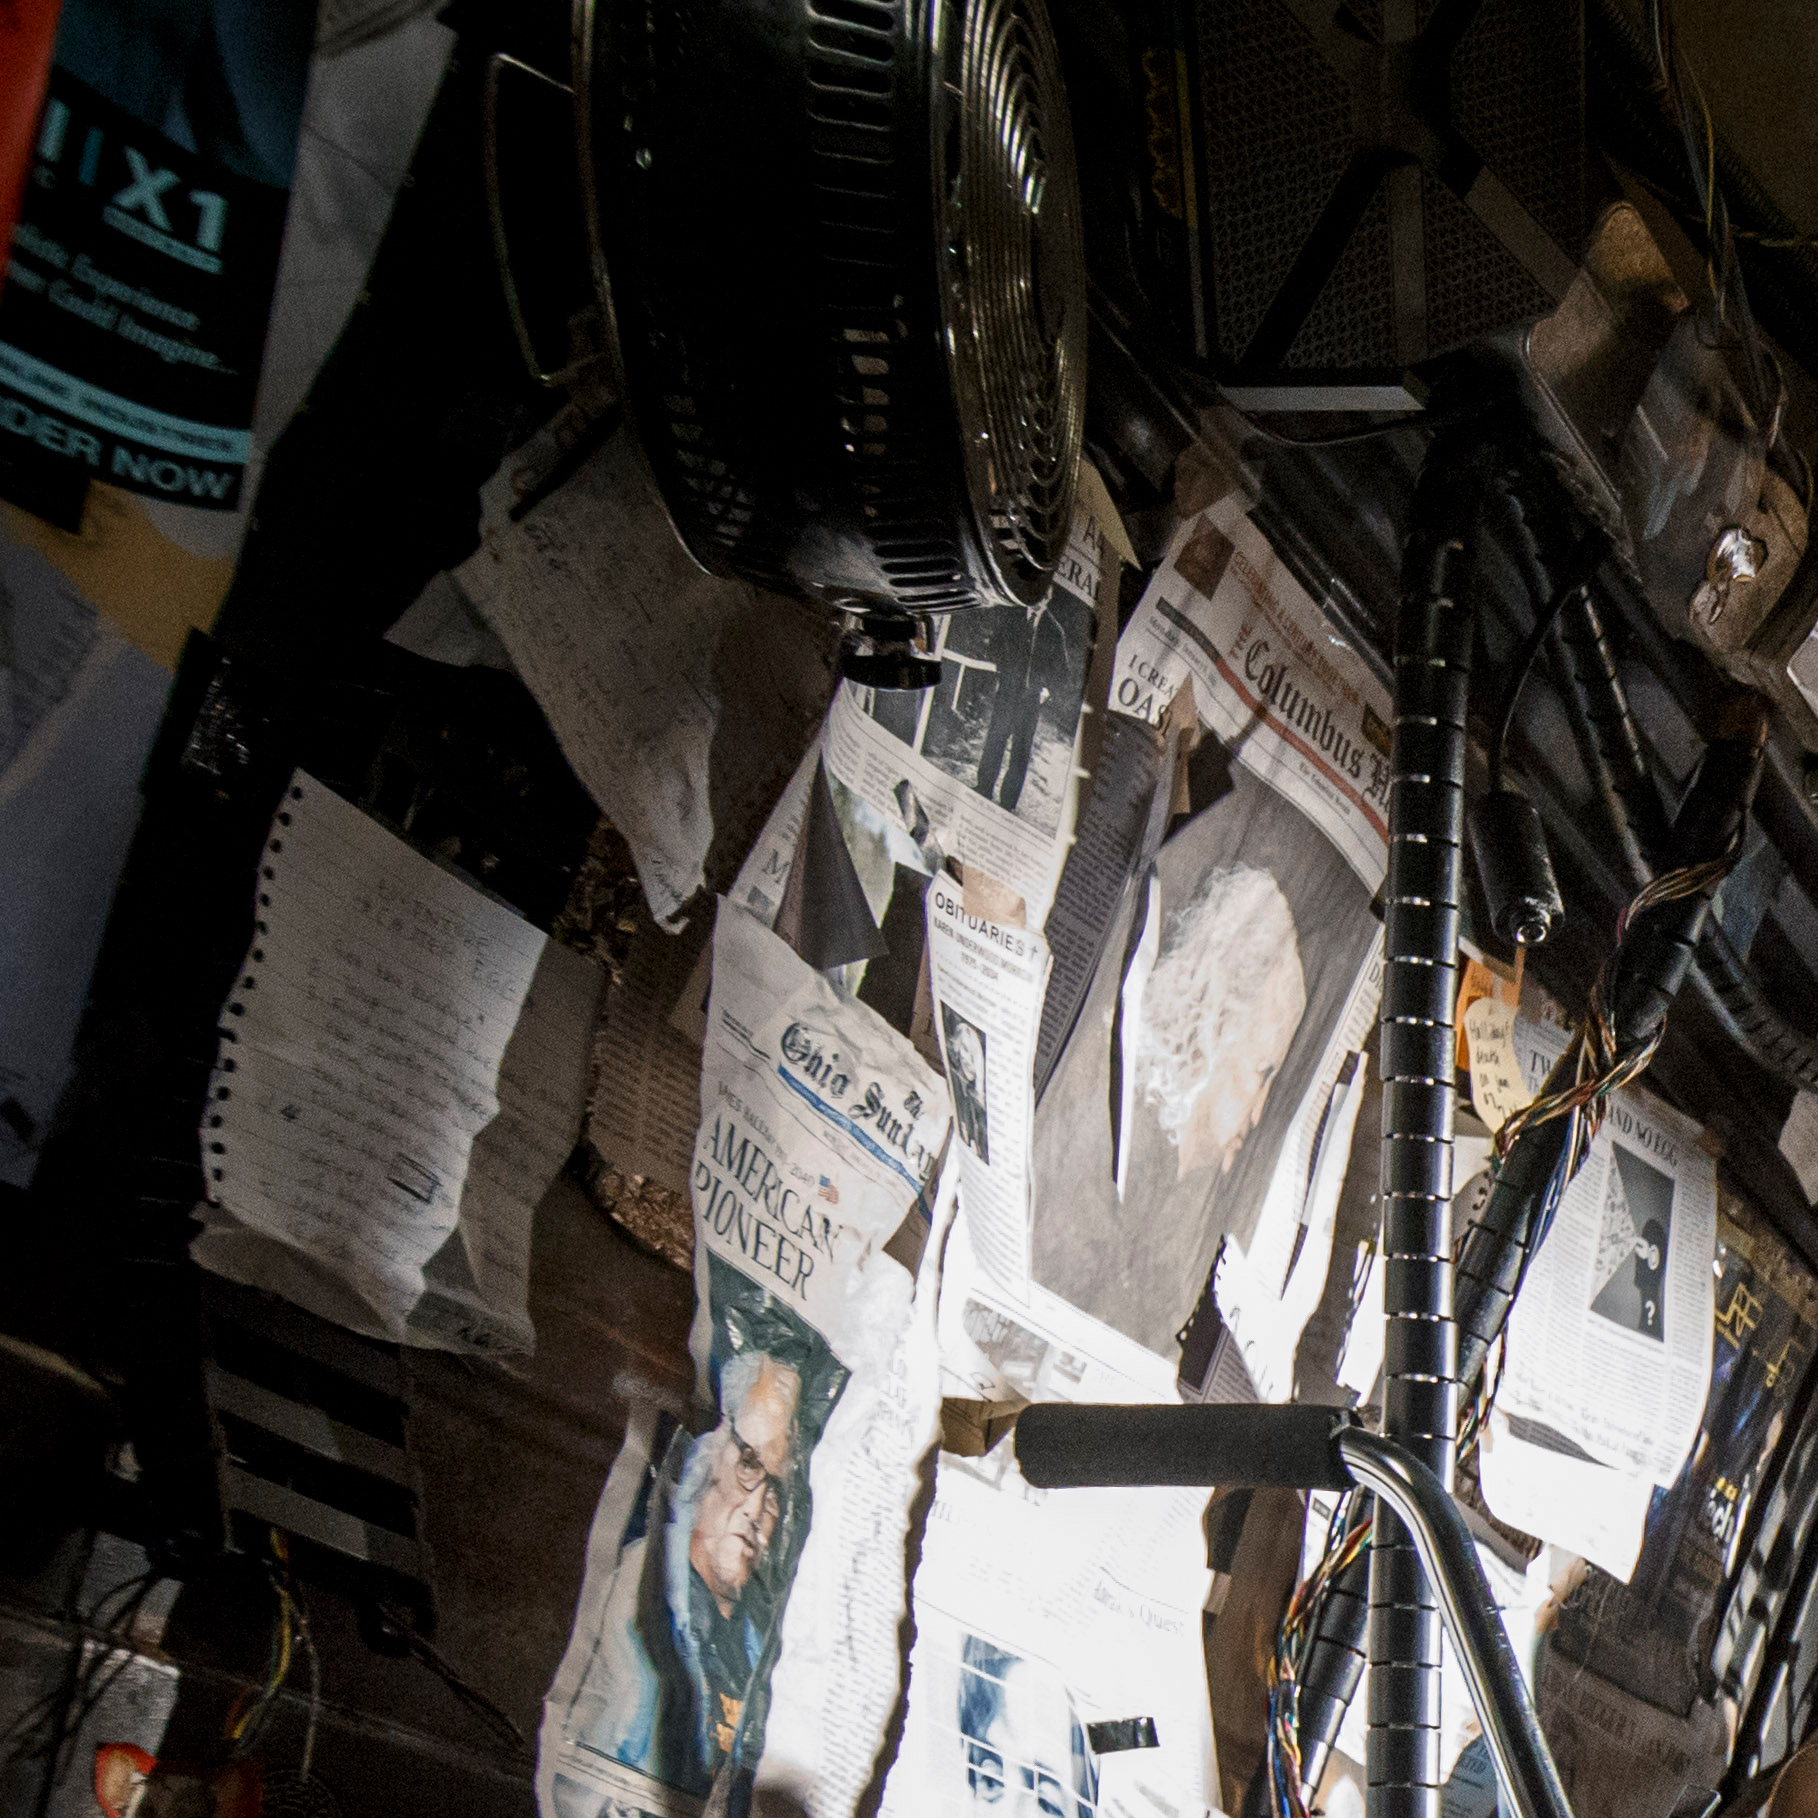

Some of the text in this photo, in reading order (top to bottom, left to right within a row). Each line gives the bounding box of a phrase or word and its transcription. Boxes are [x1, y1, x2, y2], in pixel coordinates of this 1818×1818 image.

[111, 145, 229, 255] X1
[110, 443, 237, 502] NOW
[1244, 639, 1364, 780] Columbus
[935, 892, 1025, 956] OBITUARIES
[780, 1022, 850, 1098] Ohio
[696, 1159, 814, 1300] PIONEER
[703, 1113, 842, 1264] AMERICAN
